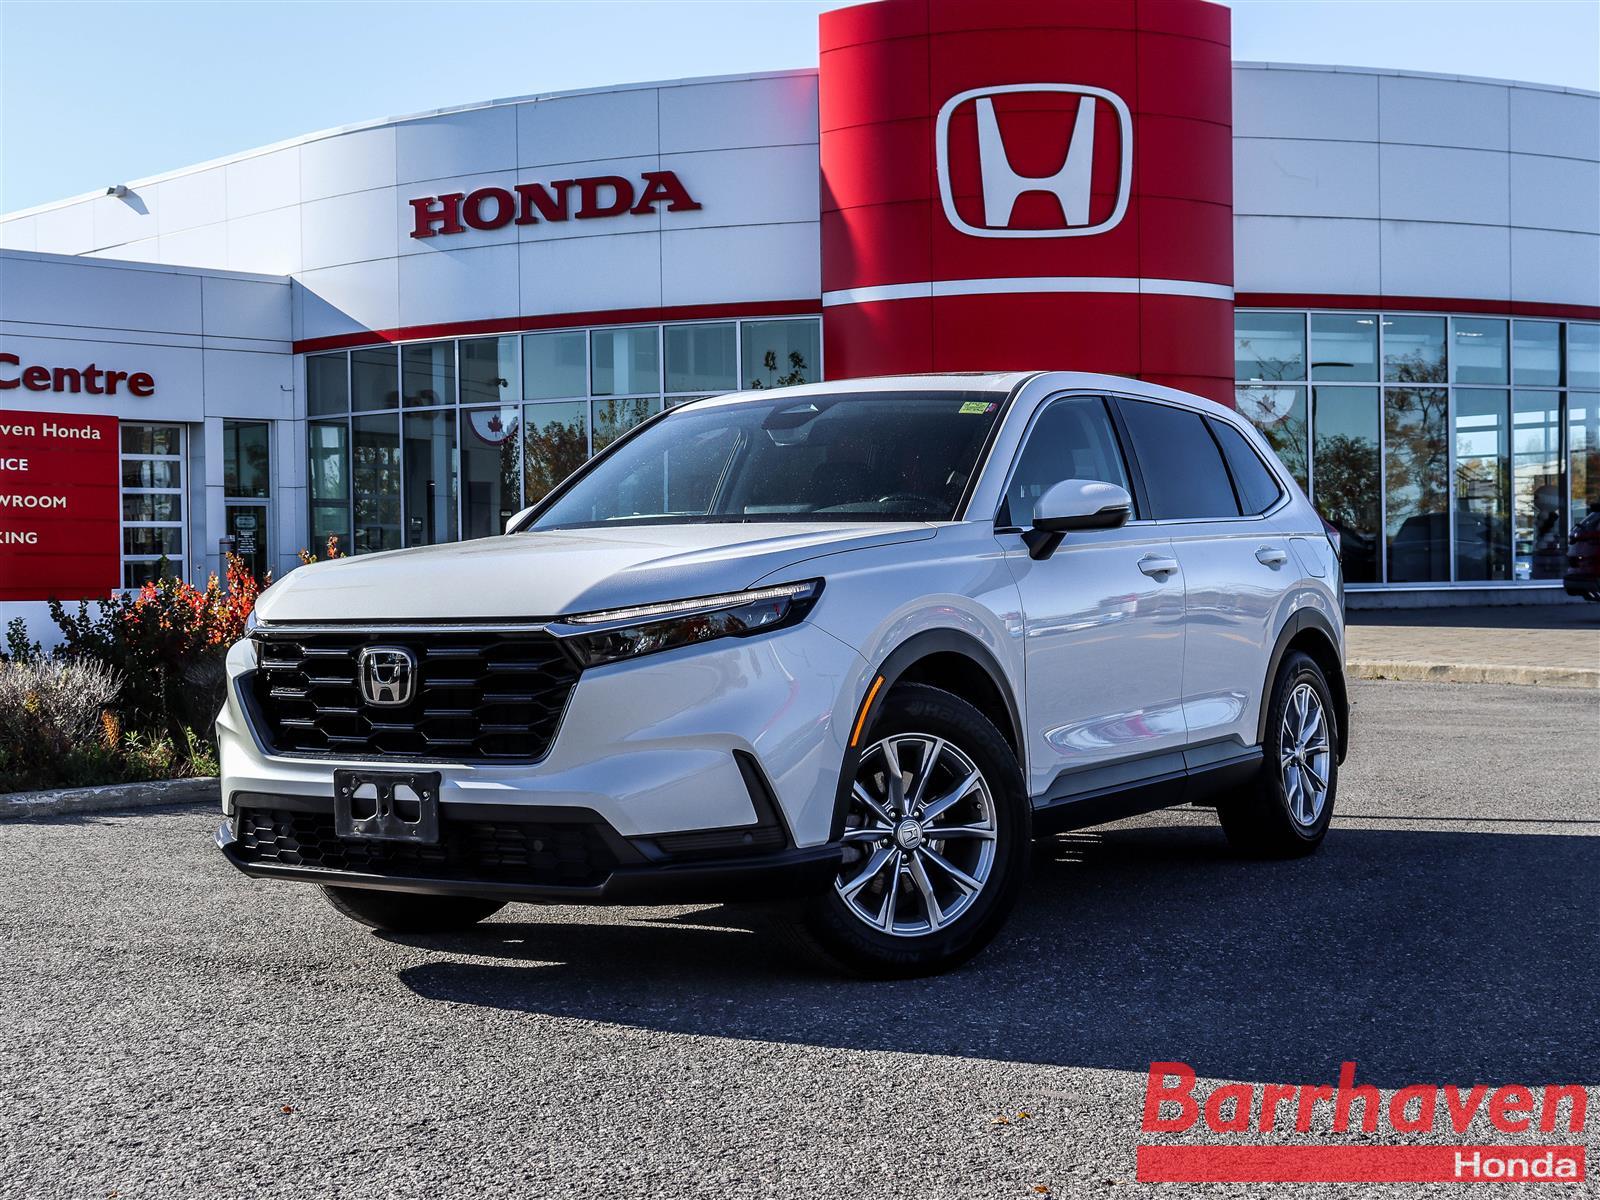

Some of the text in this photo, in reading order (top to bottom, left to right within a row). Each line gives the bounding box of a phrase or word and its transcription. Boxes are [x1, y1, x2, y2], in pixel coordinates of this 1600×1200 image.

[410, 171, 701, 238] HONDA
[0, 353, 154, 396] Centre
[43, 422, 101, 441] Honda
[1, 458, 29, 471] ICE
